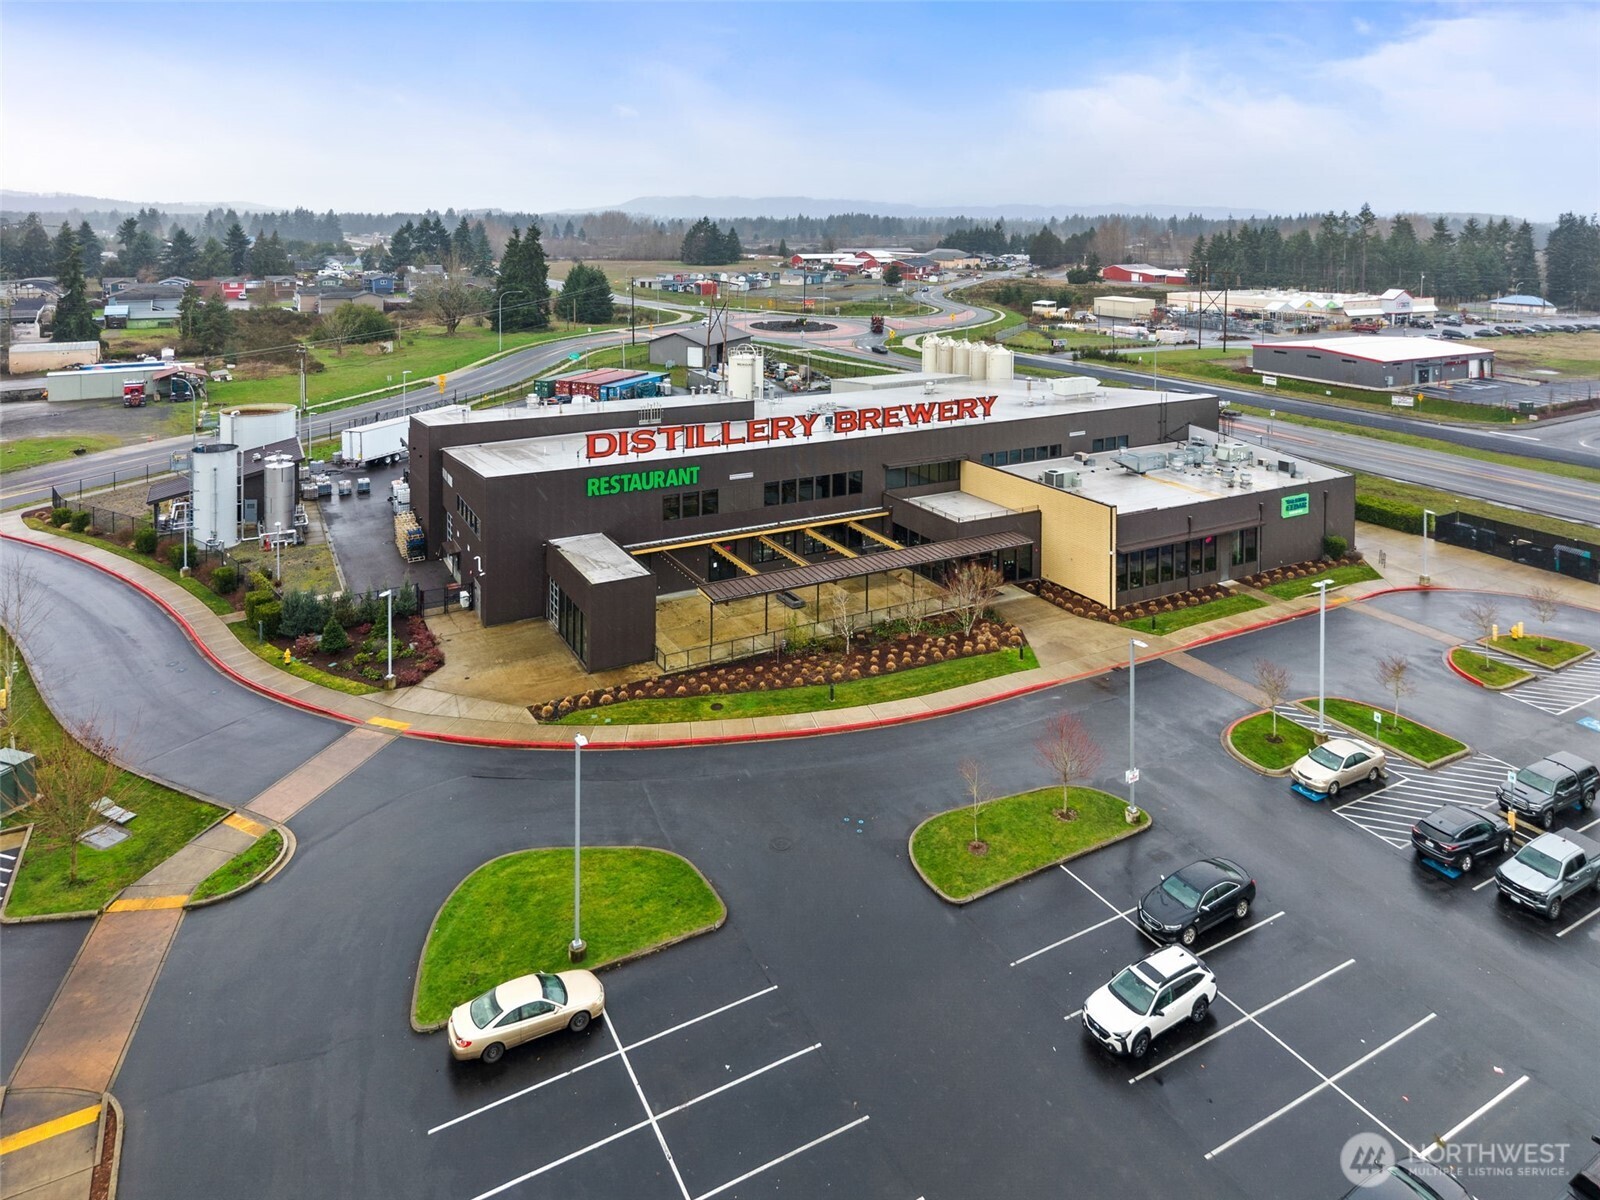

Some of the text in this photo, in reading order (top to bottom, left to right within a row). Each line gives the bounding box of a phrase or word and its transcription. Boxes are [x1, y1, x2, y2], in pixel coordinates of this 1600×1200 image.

[586, 395, 998, 459] DISTILLERY BREWERY
[587, 466, 700, 497] RESTAURANT
